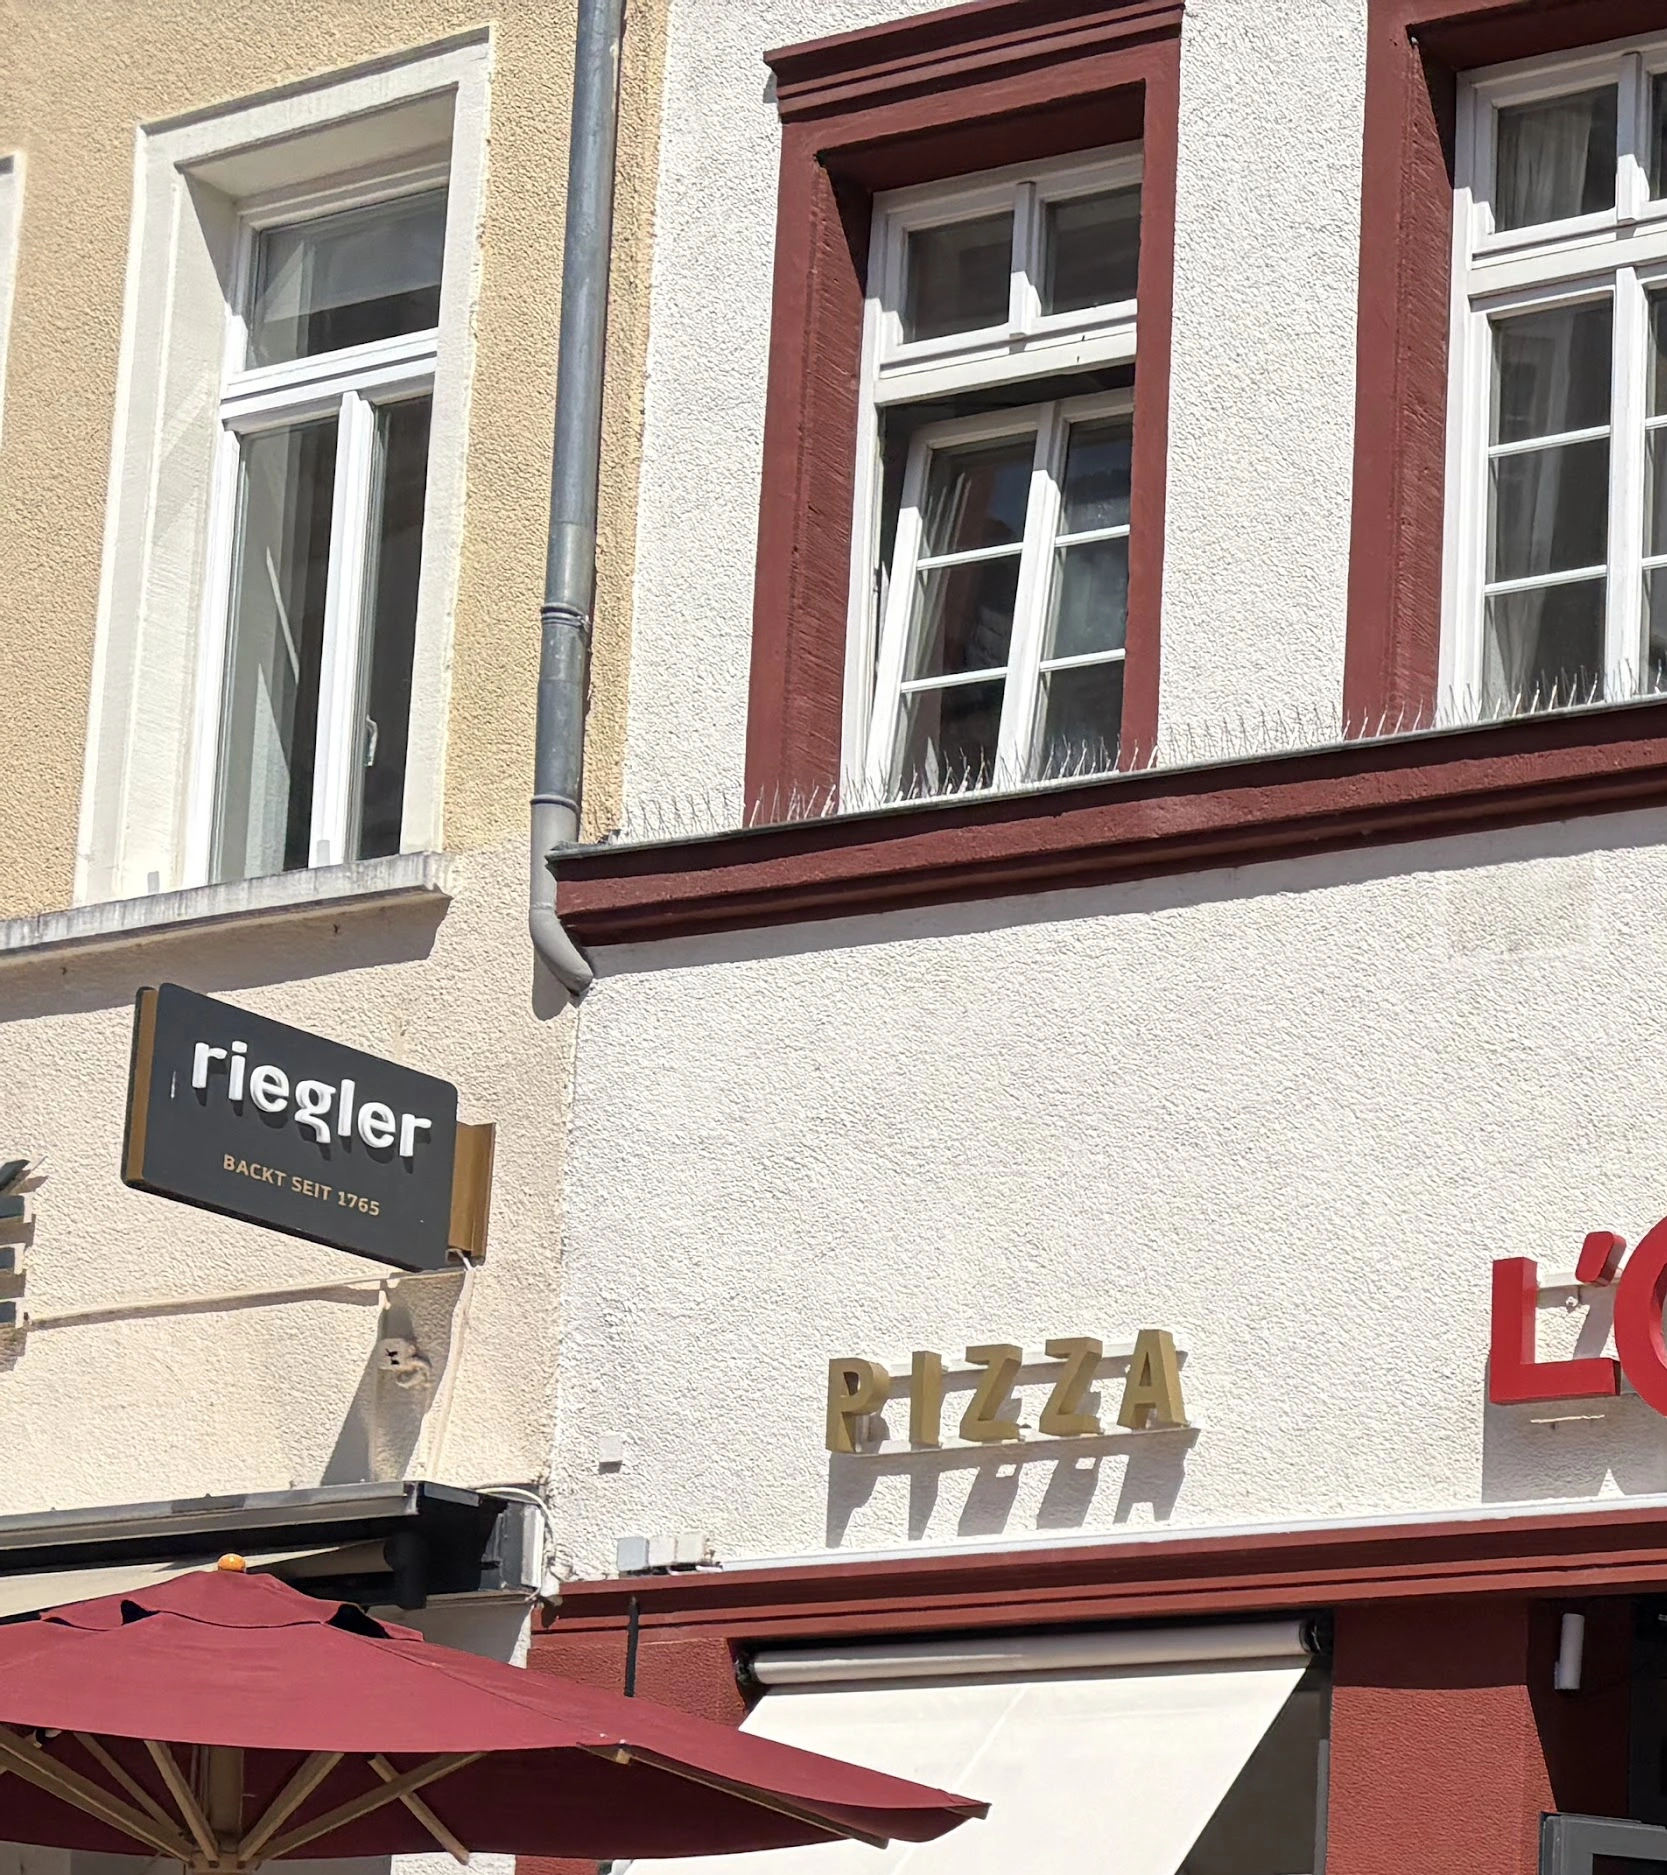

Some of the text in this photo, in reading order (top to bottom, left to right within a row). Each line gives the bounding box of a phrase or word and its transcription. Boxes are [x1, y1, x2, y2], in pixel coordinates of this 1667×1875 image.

[191, 1040, 432, 1157] riegler
[223, 1153, 381, 1217] BACKT SEIT 1765
[825, 1328, 1190, 1453] PIZZA
